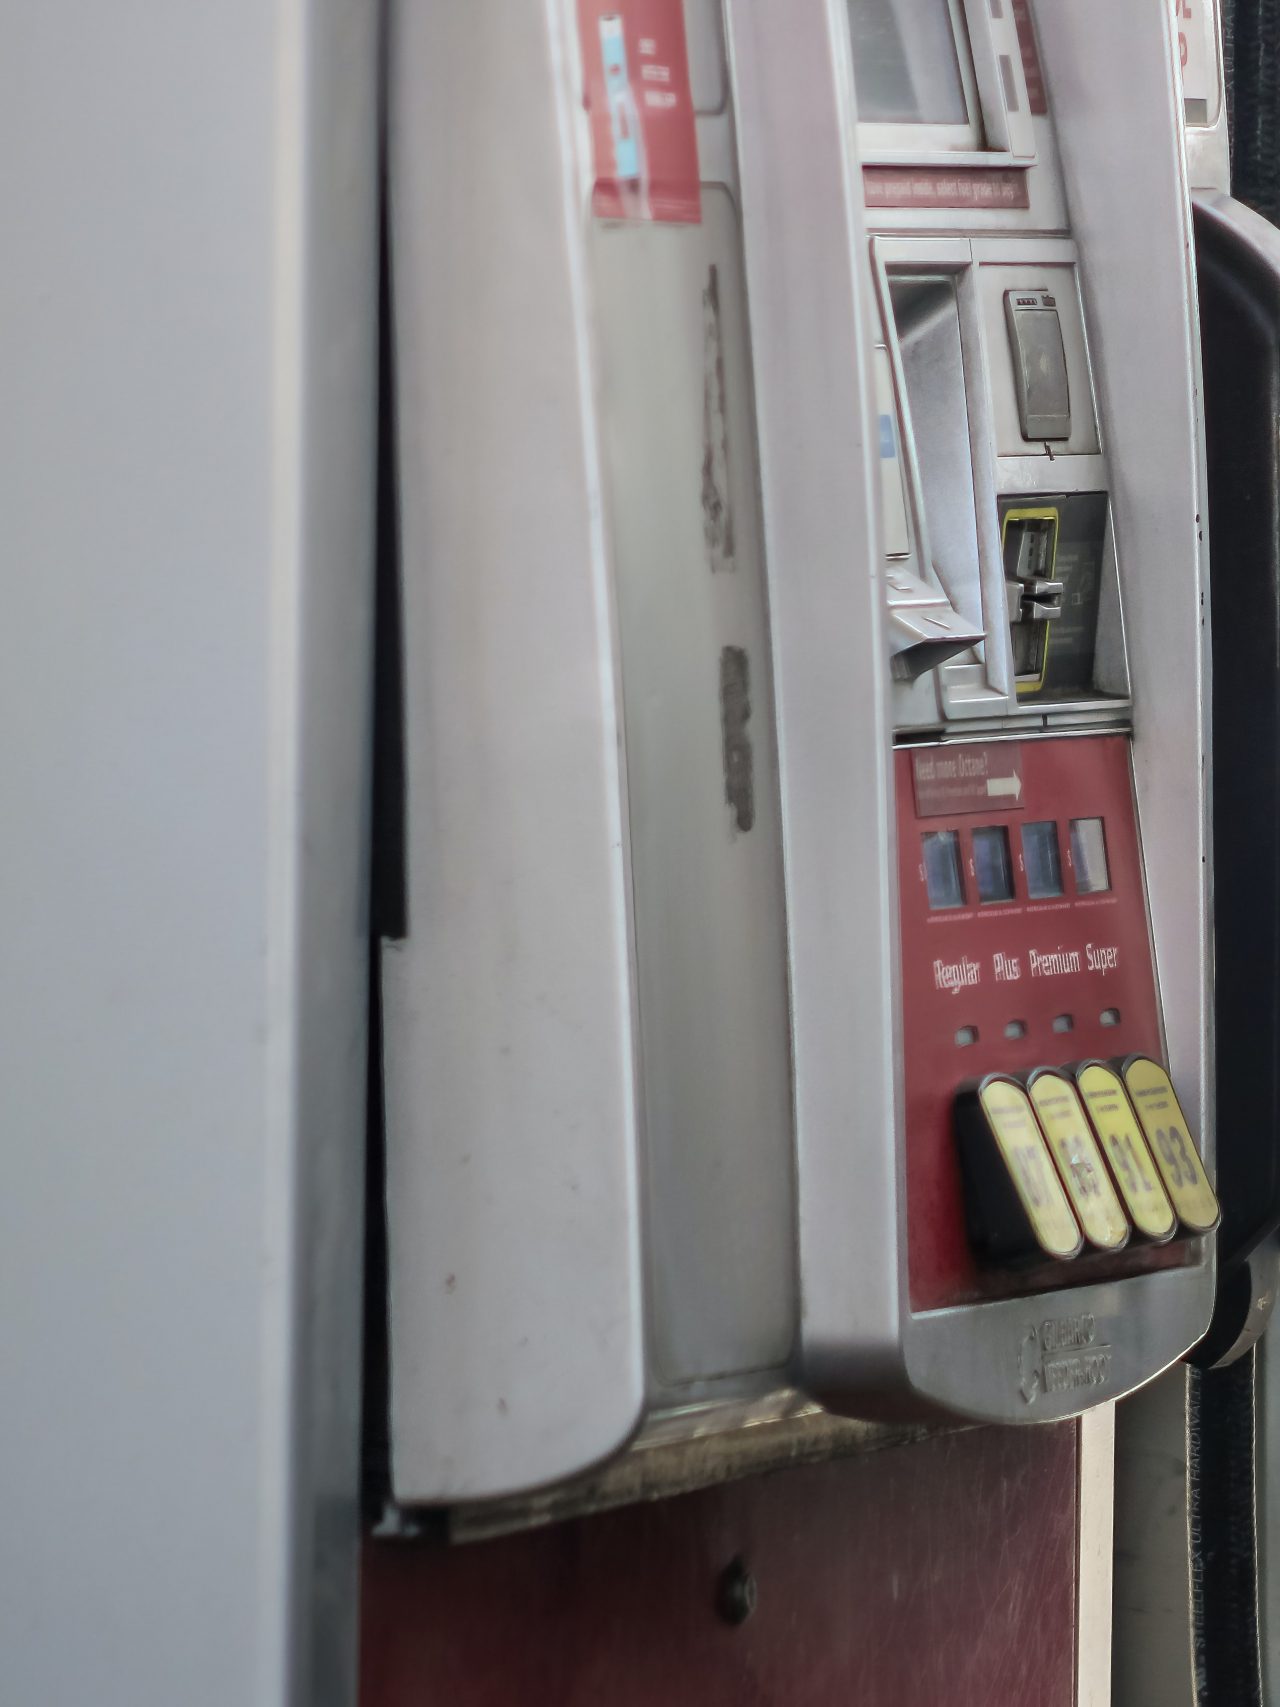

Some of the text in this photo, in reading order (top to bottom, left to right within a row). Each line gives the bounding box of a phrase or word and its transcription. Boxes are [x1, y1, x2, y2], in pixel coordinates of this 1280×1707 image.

[933, 943, 1119, 995] Regular Plus Premium Super
[1155, 1125, 1198, 1188] 93
